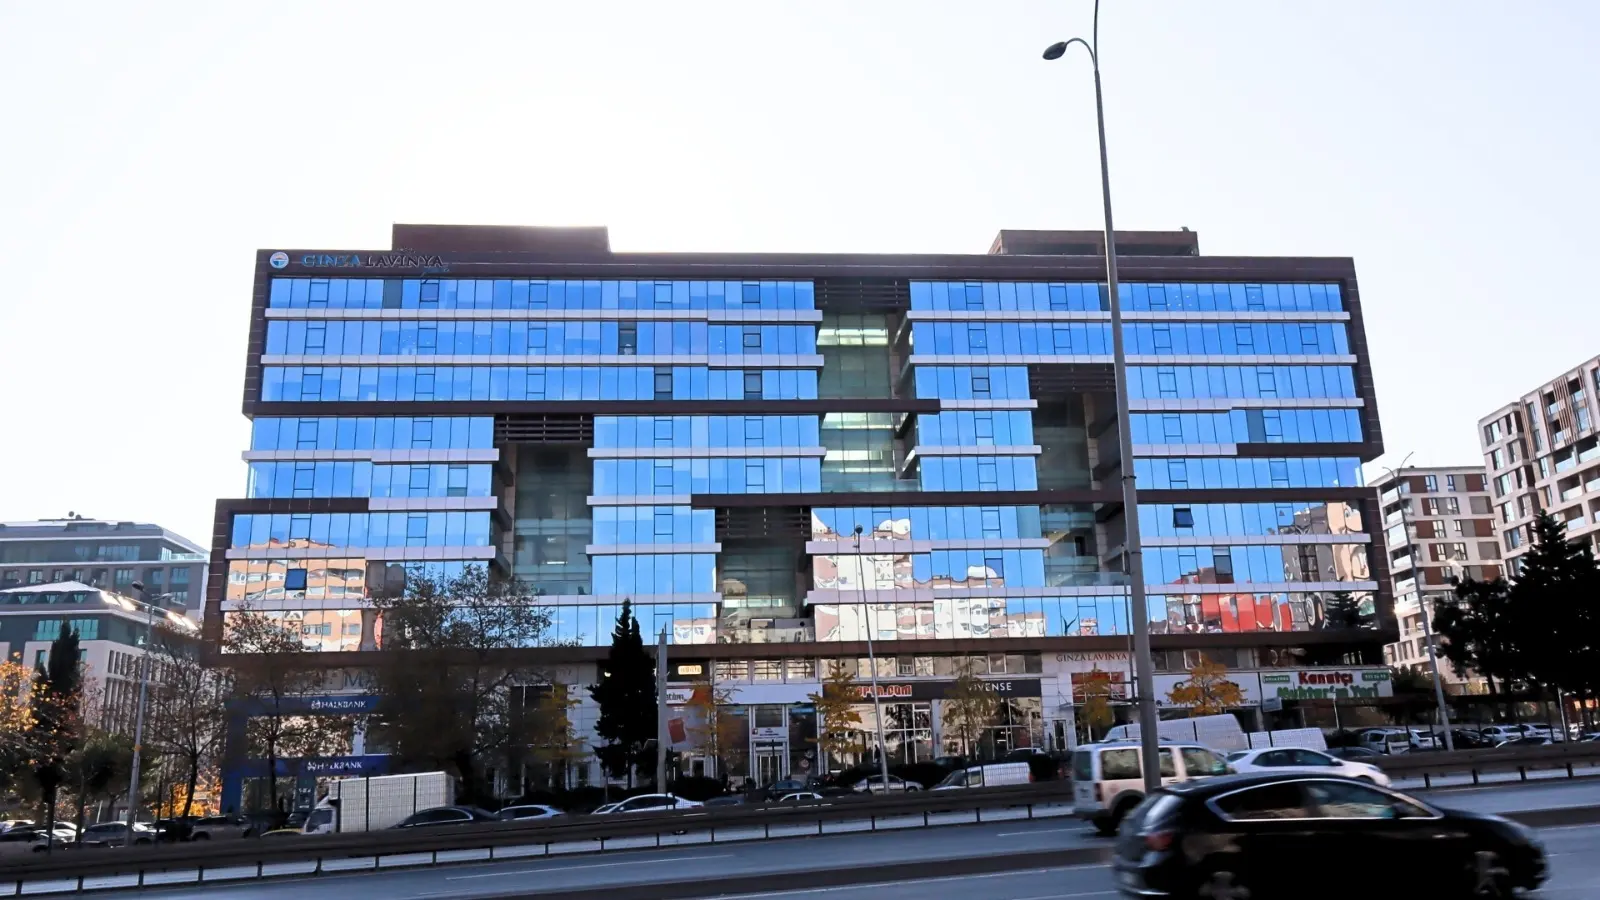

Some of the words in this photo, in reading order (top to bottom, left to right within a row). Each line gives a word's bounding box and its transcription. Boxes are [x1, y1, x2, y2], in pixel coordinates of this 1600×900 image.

[301, 254, 361, 268] GINZA
[365, 254, 444, 269] LAVINYA
[1056, 652, 1086, 662] GINZA
[1088, 651, 1127, 662] LAVINYA
[967, 682, 1013, 692] VIVENSE
[321, 701, 367, 709] HALKBANK
[317, 761, 363, 770] HLKBANK
